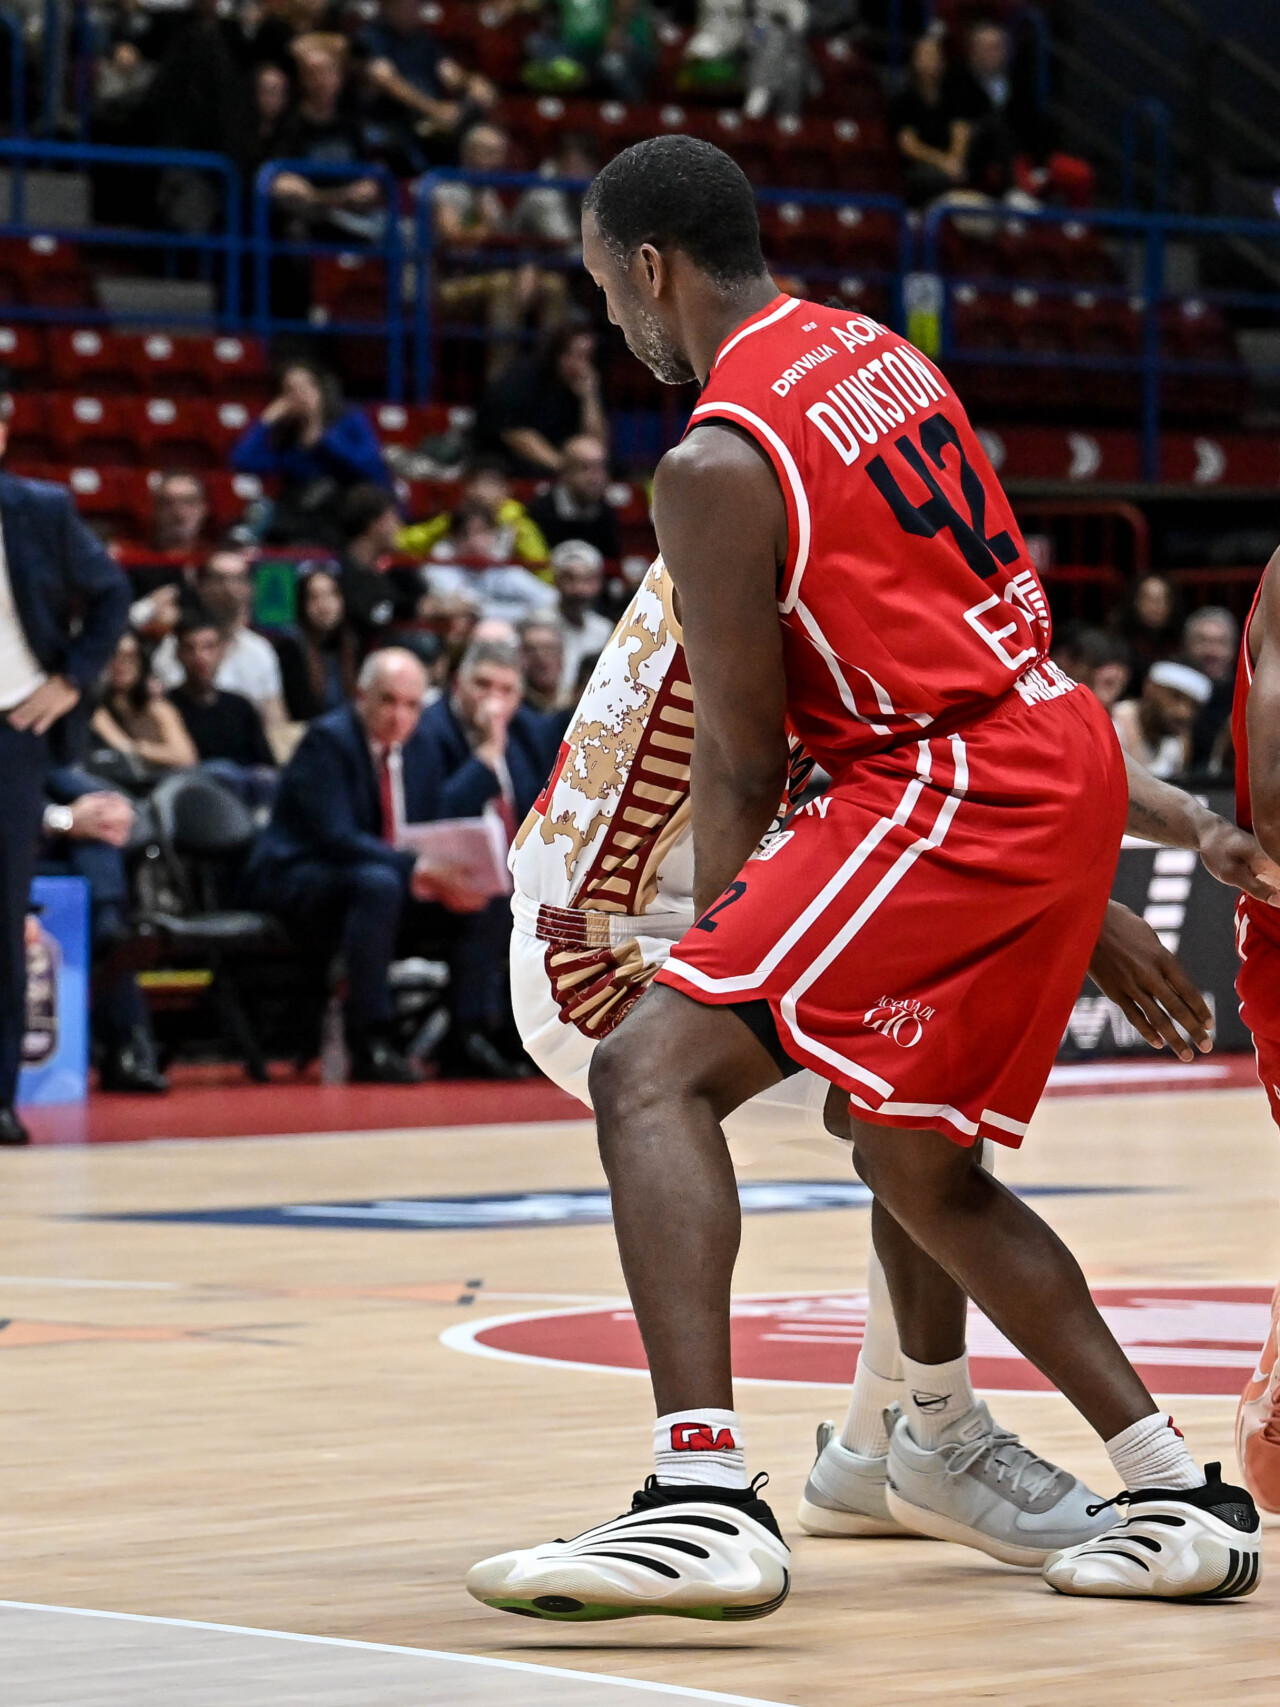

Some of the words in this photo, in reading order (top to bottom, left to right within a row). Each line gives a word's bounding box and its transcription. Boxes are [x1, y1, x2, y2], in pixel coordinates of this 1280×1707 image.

[830, 315, 889, 354] AON
[771, 343, 838, 398] DRIVALIA
[805, 344, 947, 466] DUNSTON
[864, 412, 1020, 580] 42
[695, 880, 747, 933] 2
